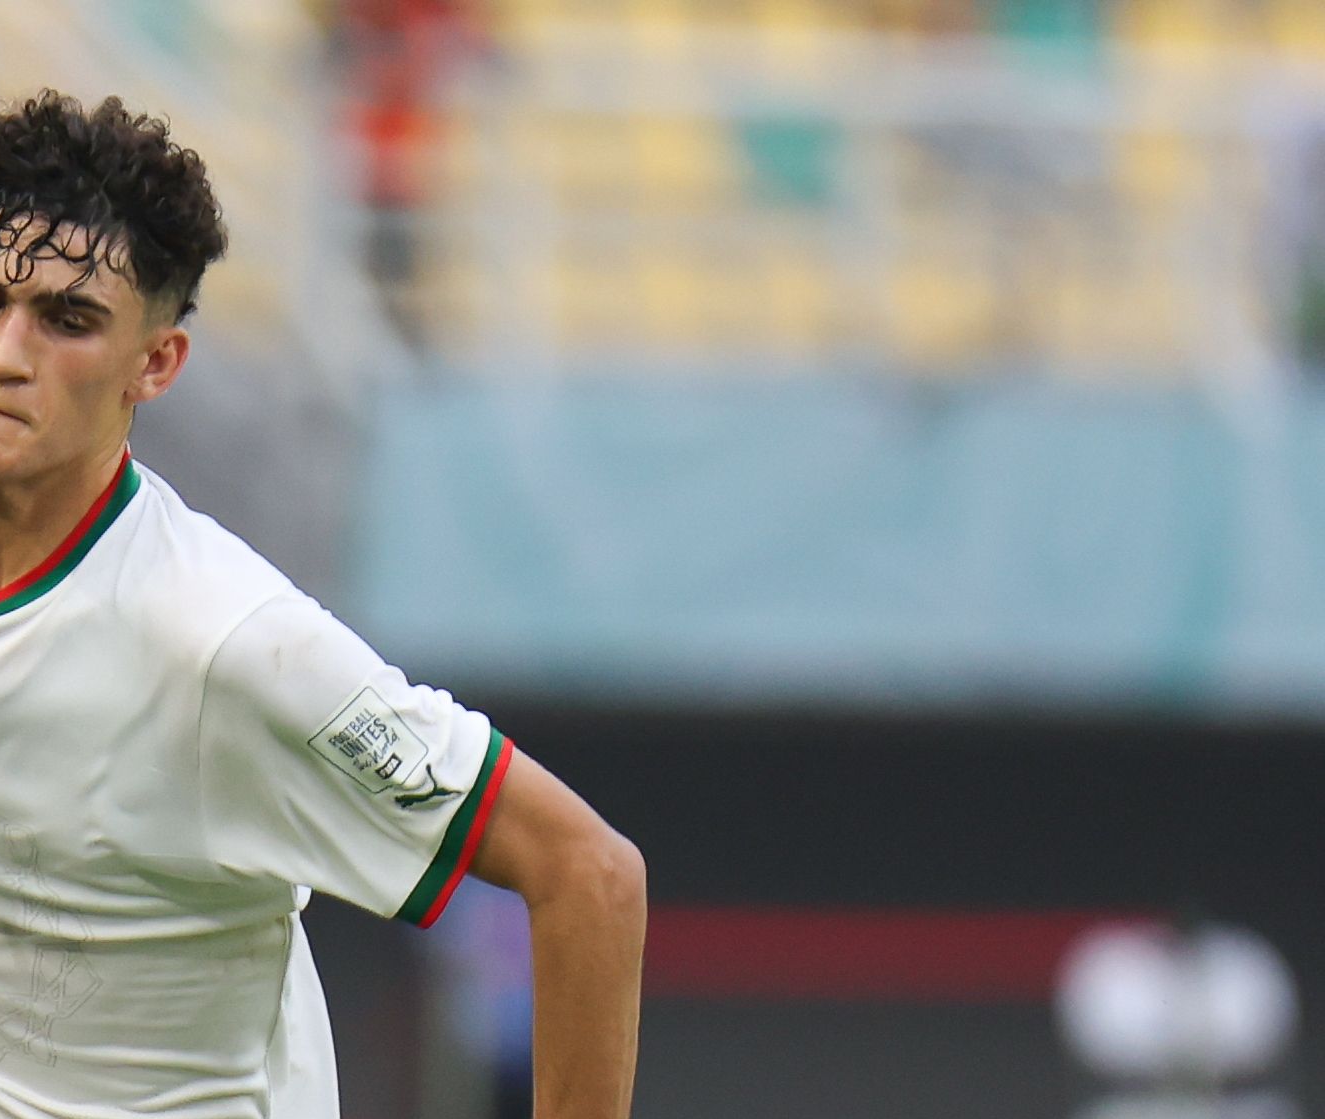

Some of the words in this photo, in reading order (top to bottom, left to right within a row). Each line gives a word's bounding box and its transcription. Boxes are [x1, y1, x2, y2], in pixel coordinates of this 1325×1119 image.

[328, 708, 376, 747] FOOTBALL
[339, 717, 387, 758] UNITES
[368, 727, 400, 764] World
